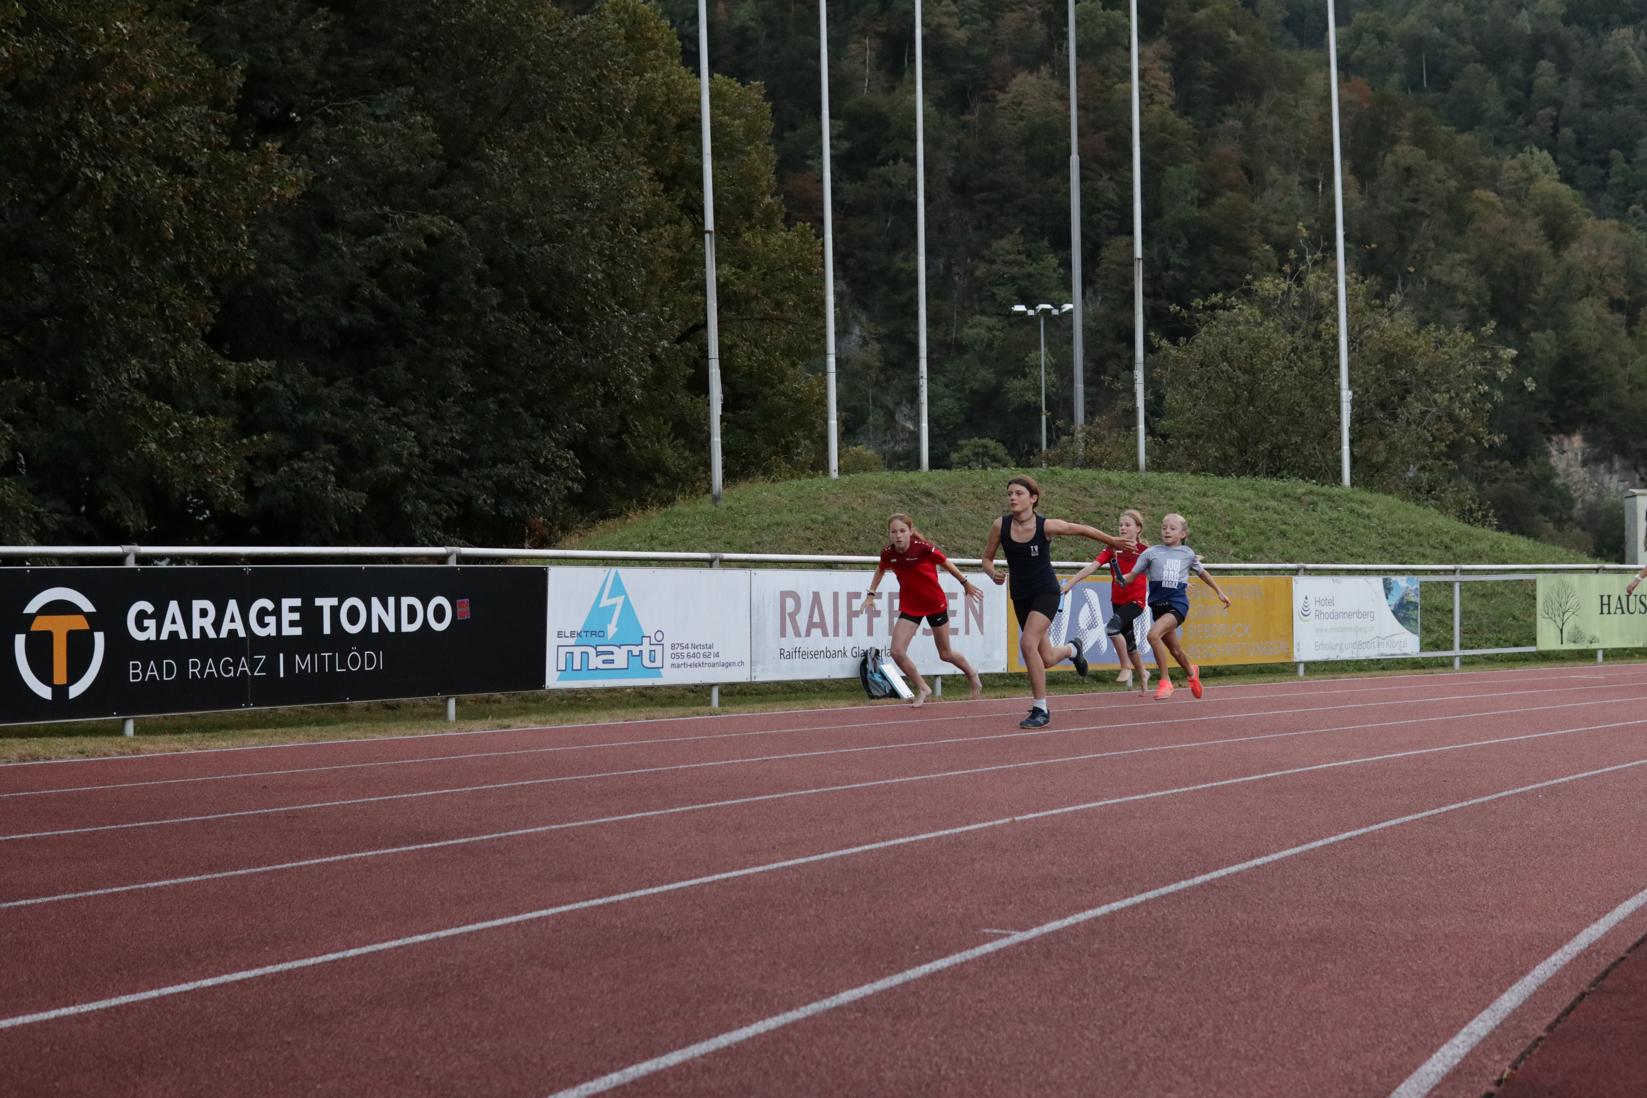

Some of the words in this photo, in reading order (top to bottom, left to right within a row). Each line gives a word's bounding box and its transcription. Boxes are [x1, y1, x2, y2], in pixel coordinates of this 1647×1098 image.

[1163, 559, 1181, 571] JUGI
[1315, 596, 1335, 607] Hotel
[1600, 594, 1647, 615] HAUS
[126, 598, 303, 641] GARAGE
[314, 595, 451, 635] TONDO
[779, 590, 984, 638] RAIFFEEN
[1315, 608, 1375, 621] Rhodannenberg
[557, 630, 605, 639] ELEKTRO
[556, 630, 665, 672] marti
[670, 642, 690, 651] 8754
[691, 642, 714, 650] Netstal
[779, 646, 848, 660] Raiffeisenbank
[670, 651, 685, 660] 055
[687, 650, 701, 660] 640
[702, 650, 712, 659] 62
[129, 659, 177, 682] BAD
[188, 655, 267, 680] RAGAZ
[295, 647, 384, 674] MITLÖDI
[670, 660, 745, 670] marti-elektroanlagen.ch
